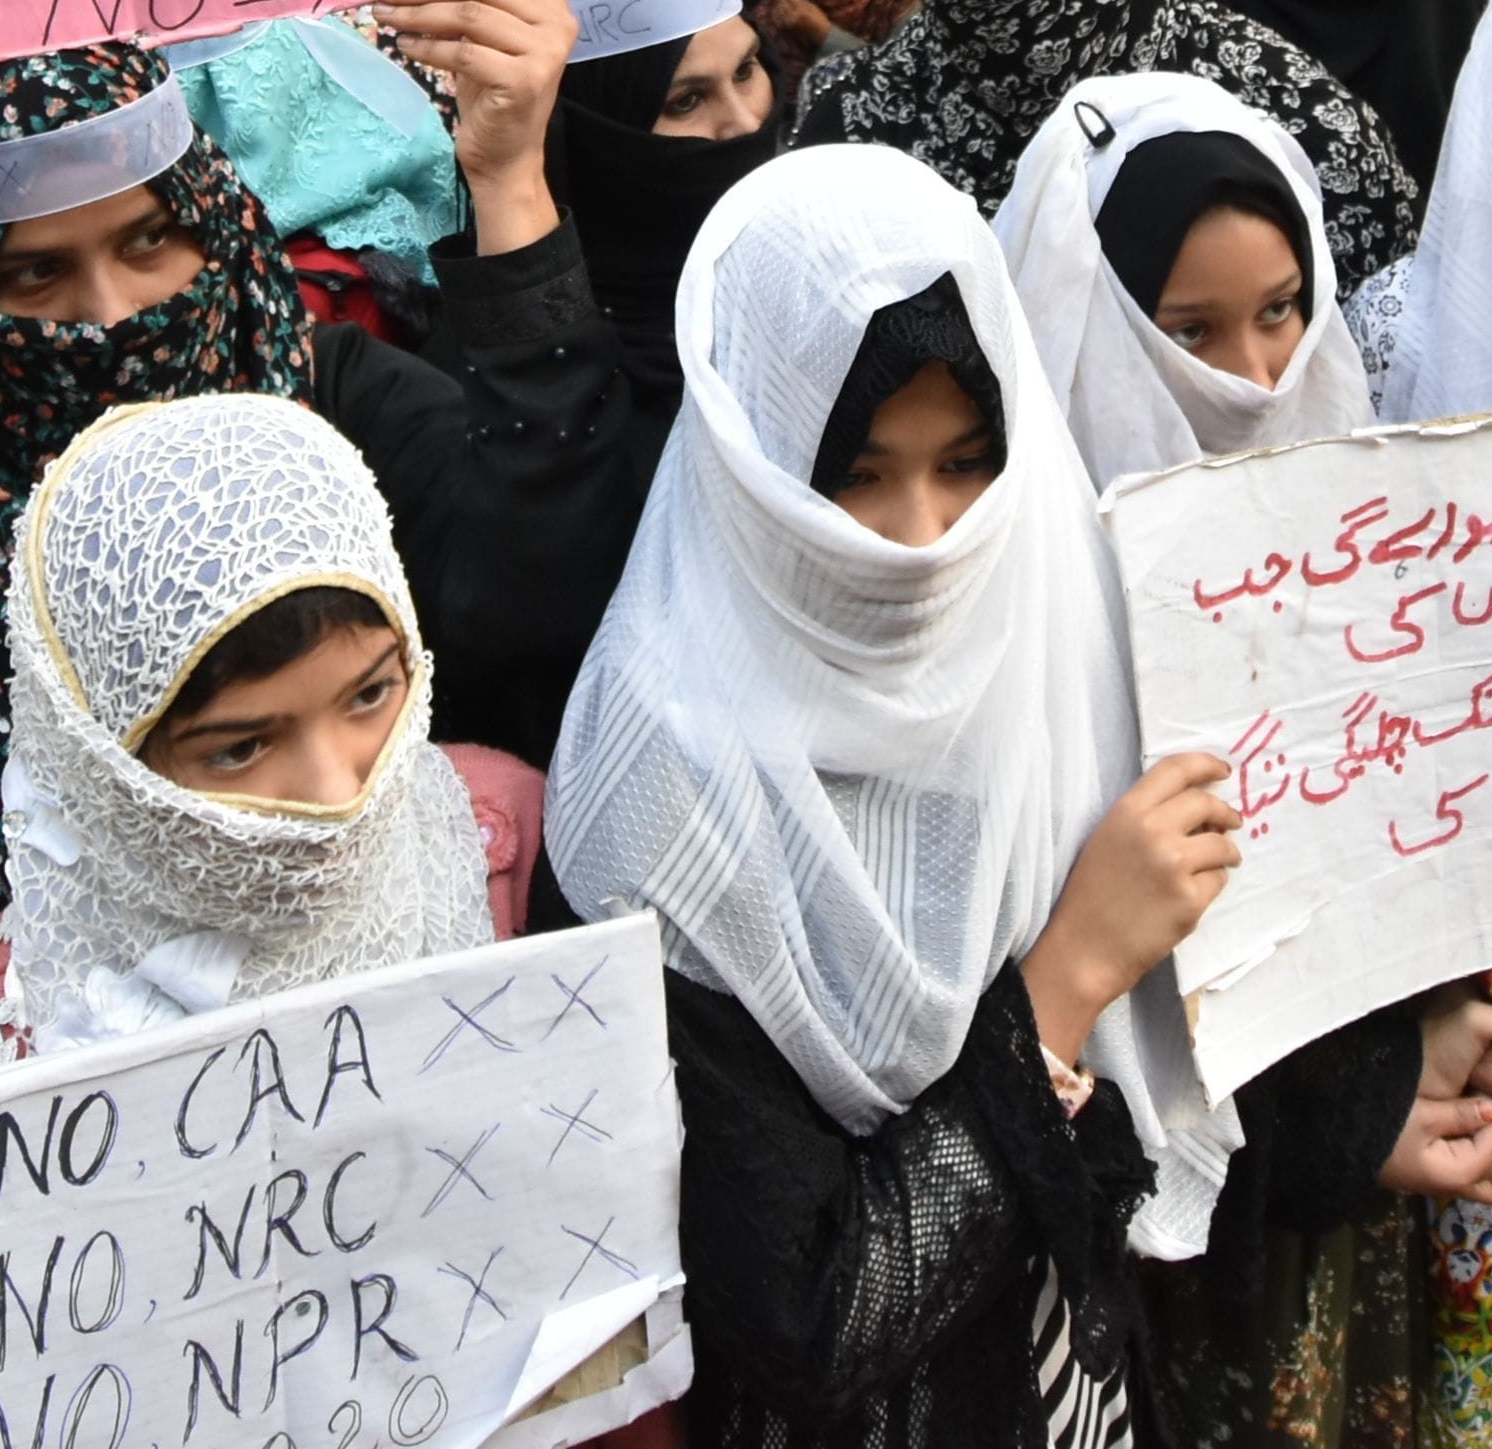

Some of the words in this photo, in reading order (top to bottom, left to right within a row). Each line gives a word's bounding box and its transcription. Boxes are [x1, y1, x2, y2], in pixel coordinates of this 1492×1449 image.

[1300, 496, 1389, 587] گی
[1194, 552, 1292, 623] جب
[1344, 582, 1447, 663] کی
[1388, 774, 1489, 857] کی
[174, 1004, 382, 1158] CAA
[183, 1151, 378, 1304] NRC
[183, 1272, 420, 1447] NPR
